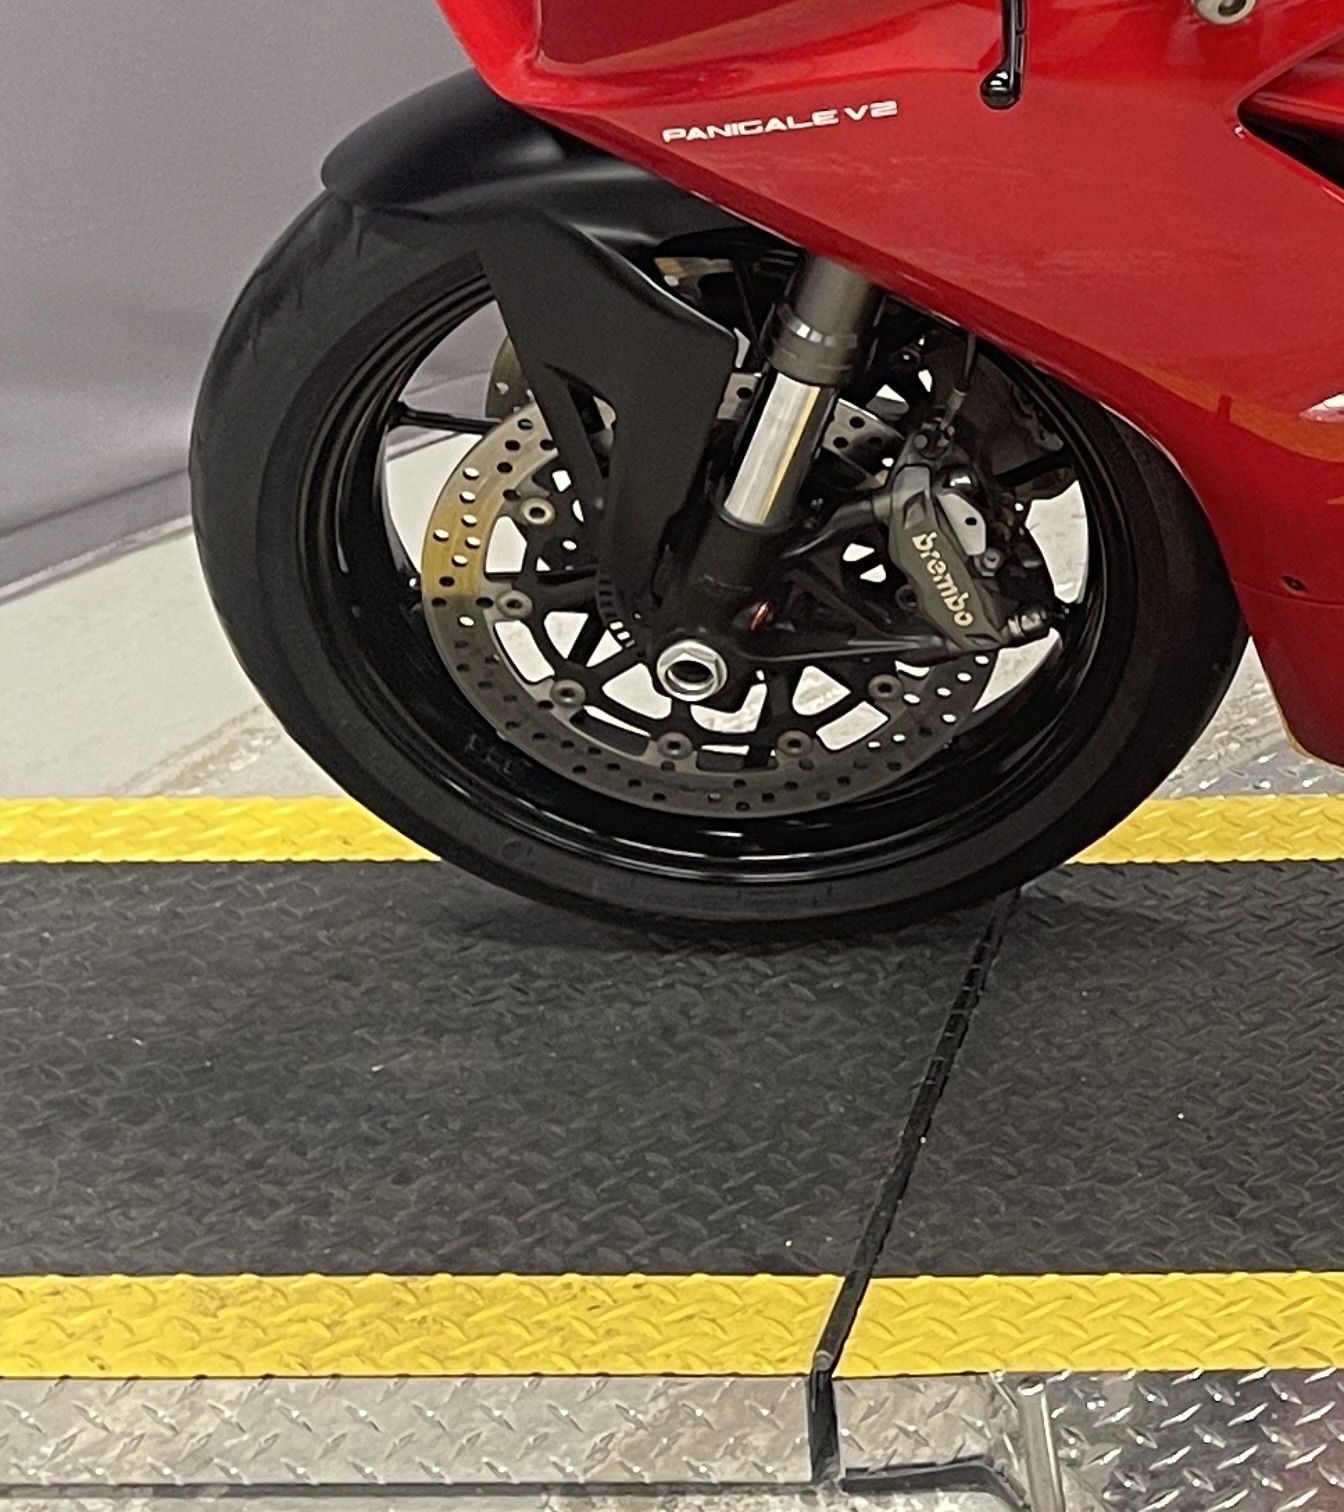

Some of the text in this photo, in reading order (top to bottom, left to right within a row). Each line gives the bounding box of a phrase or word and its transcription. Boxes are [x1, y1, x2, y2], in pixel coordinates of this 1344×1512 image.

[661, 99, 899, 143] PANIGALE V2
[911, 531, 974, 627] brembo
